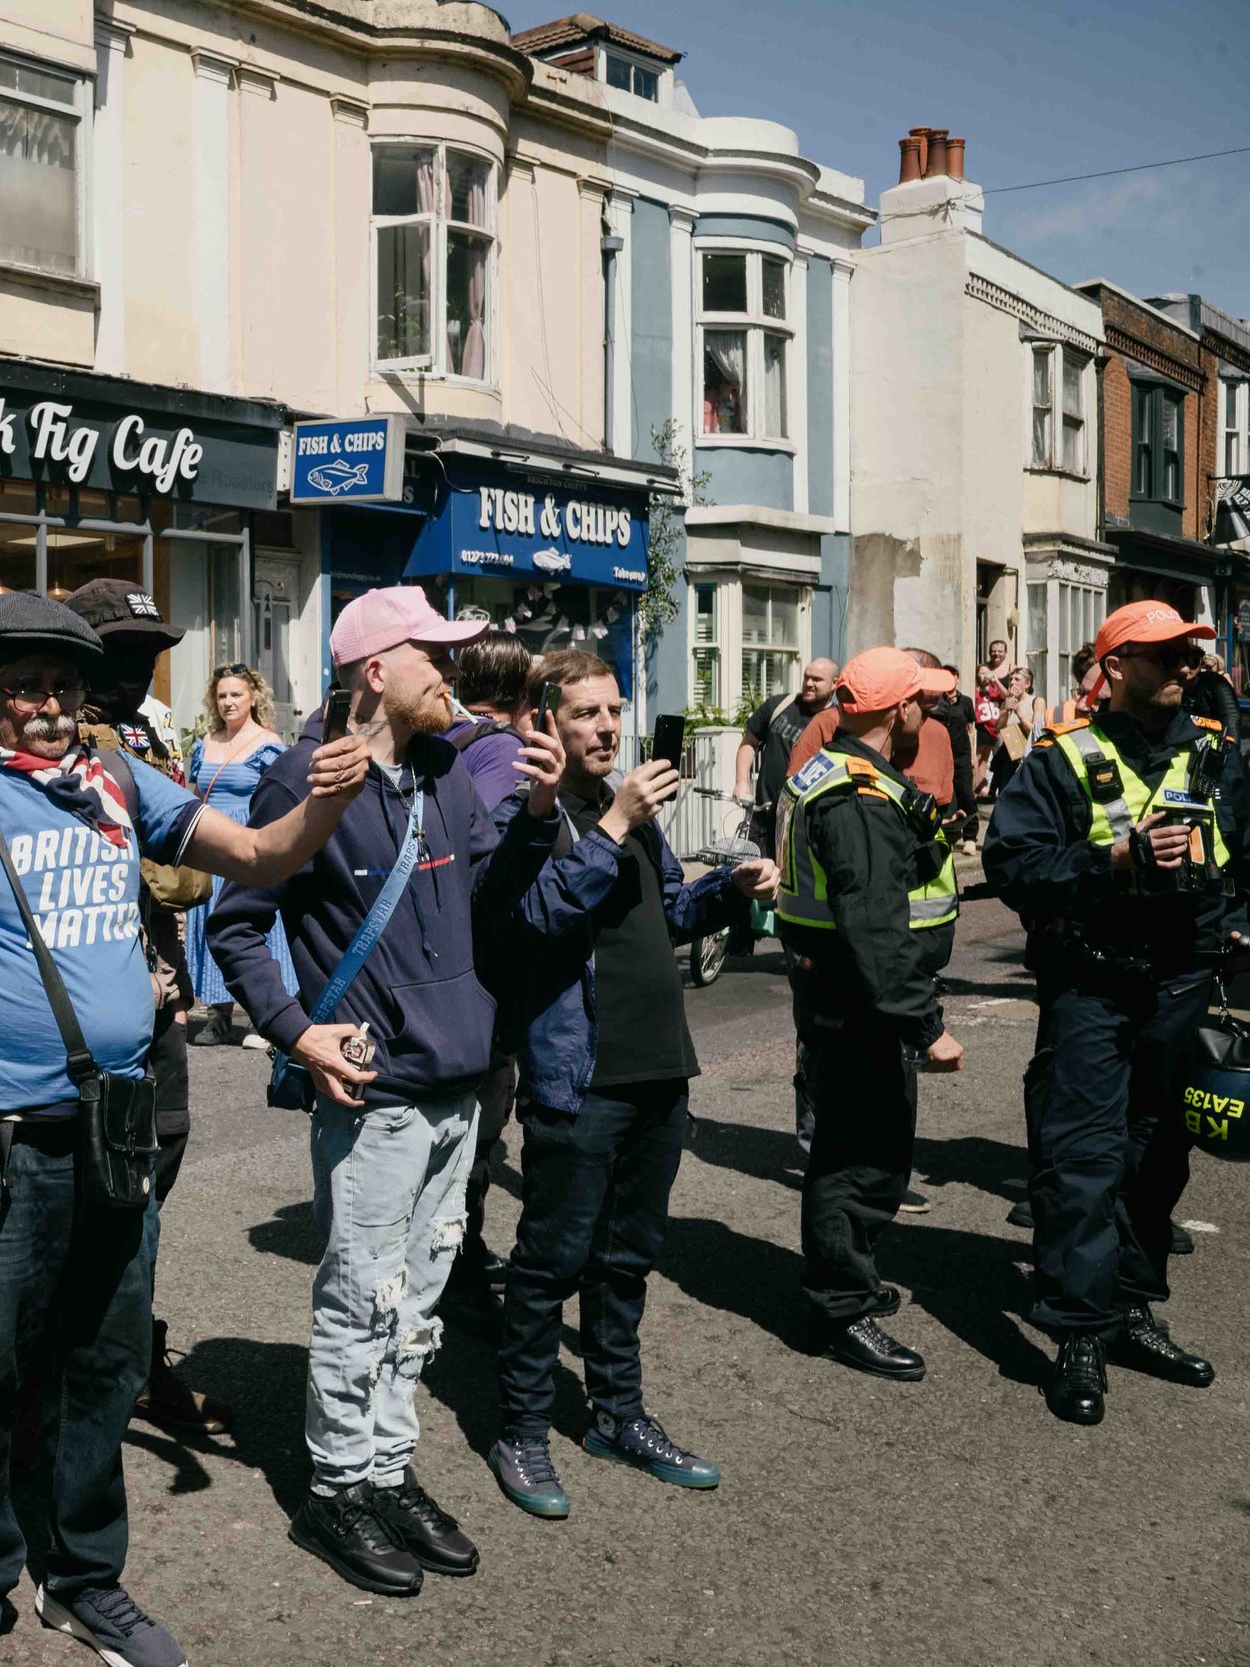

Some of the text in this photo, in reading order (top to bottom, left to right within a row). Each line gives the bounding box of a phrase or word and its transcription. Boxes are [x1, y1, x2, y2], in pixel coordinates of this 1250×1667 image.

[30, 402, 99, 483] Fig
[112, 415, 203, 493] Cafe
[299, 431, 384, 455] FISH & CHIPS
[478, 487, 631, 547] FISH & CHIPS
[39, 863, 129, 911] LIVES
[26, 901, 140, 949] MATTER
[351, 899, 392, 957] TRAPSTAR
[311, 977, 347, 1025] RAPSTAR
[1183, 1086, 1245, 1119] EA135
[1185, 1109, 1229, 1141] KB
